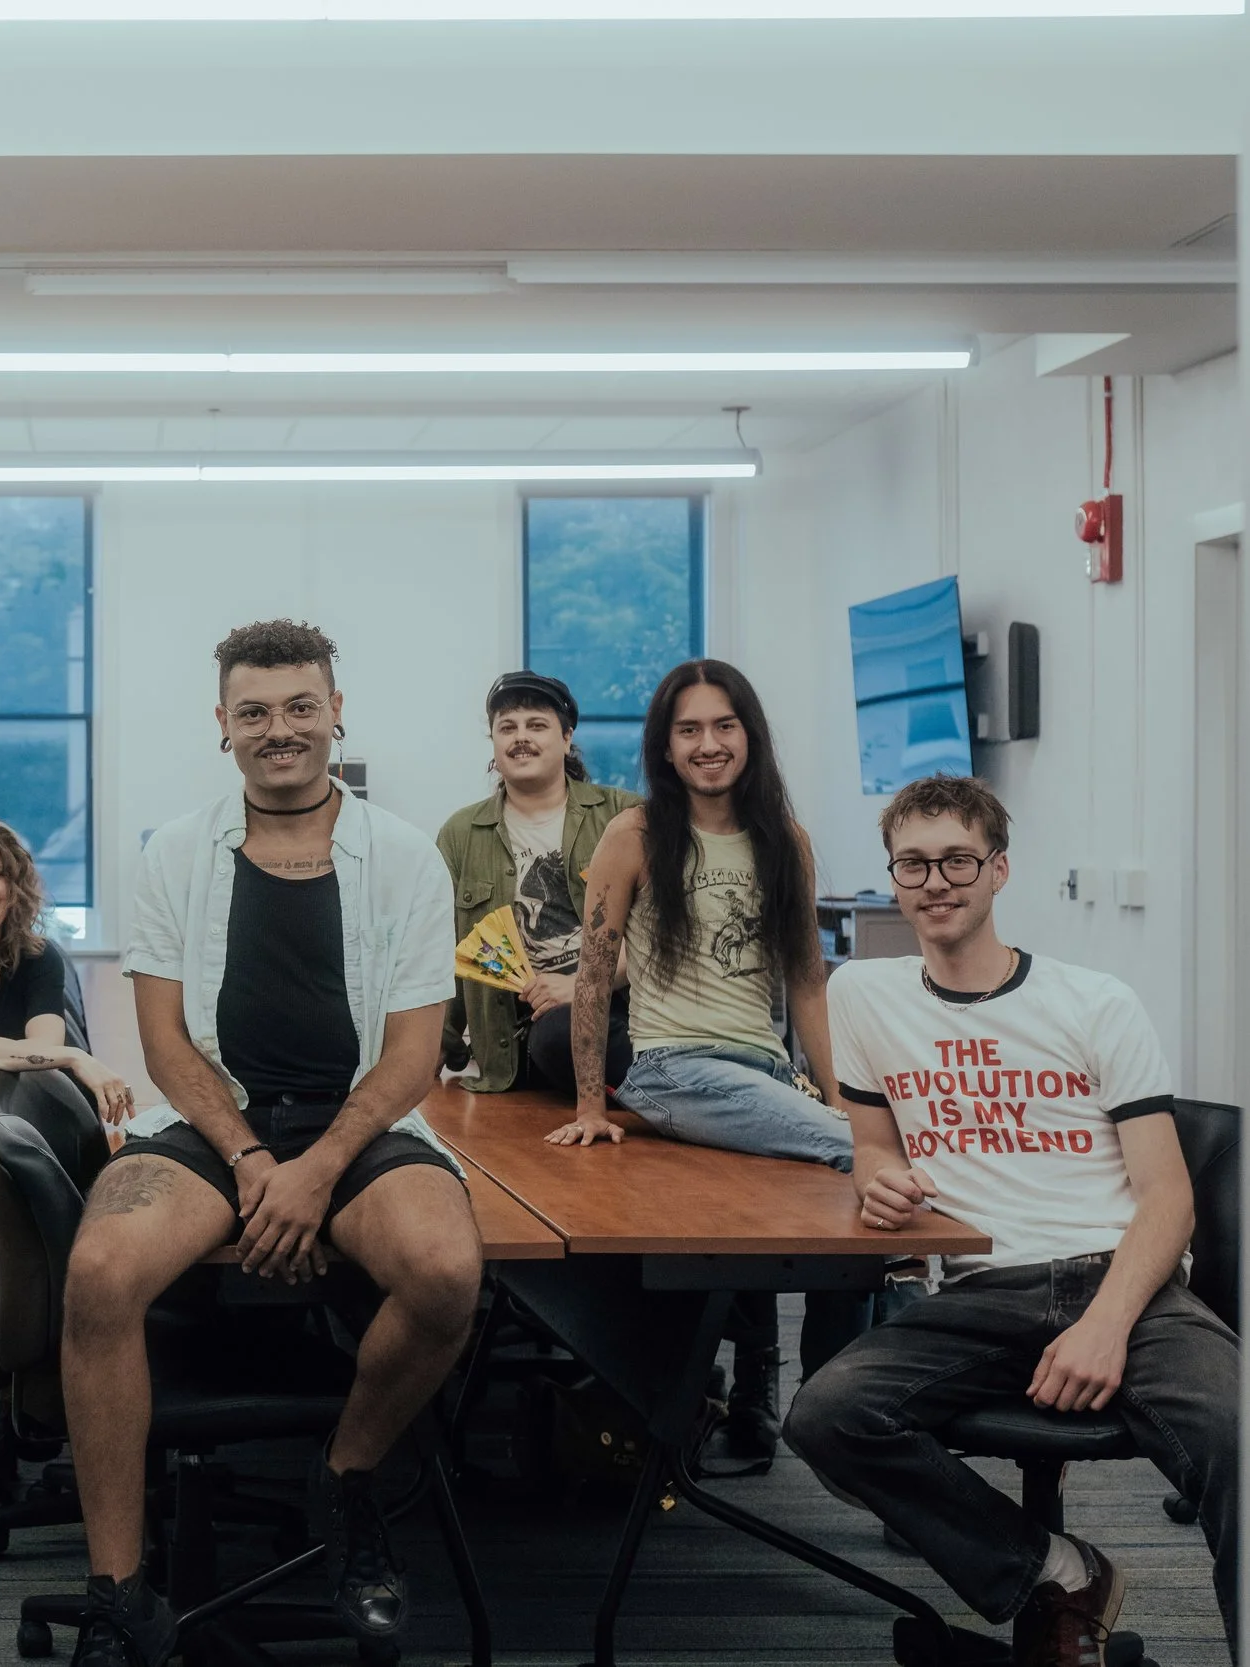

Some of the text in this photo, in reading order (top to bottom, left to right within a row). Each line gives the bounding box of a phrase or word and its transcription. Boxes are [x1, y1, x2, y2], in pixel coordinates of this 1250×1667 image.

[934, 1038, 1002, 1068] THE
[883, 1070, 1091, 1101] REVOLUTION
[928, 1098, 1027, 1128] IS MY
[905, 1127, 1093, 1159] BOYFRIEND
